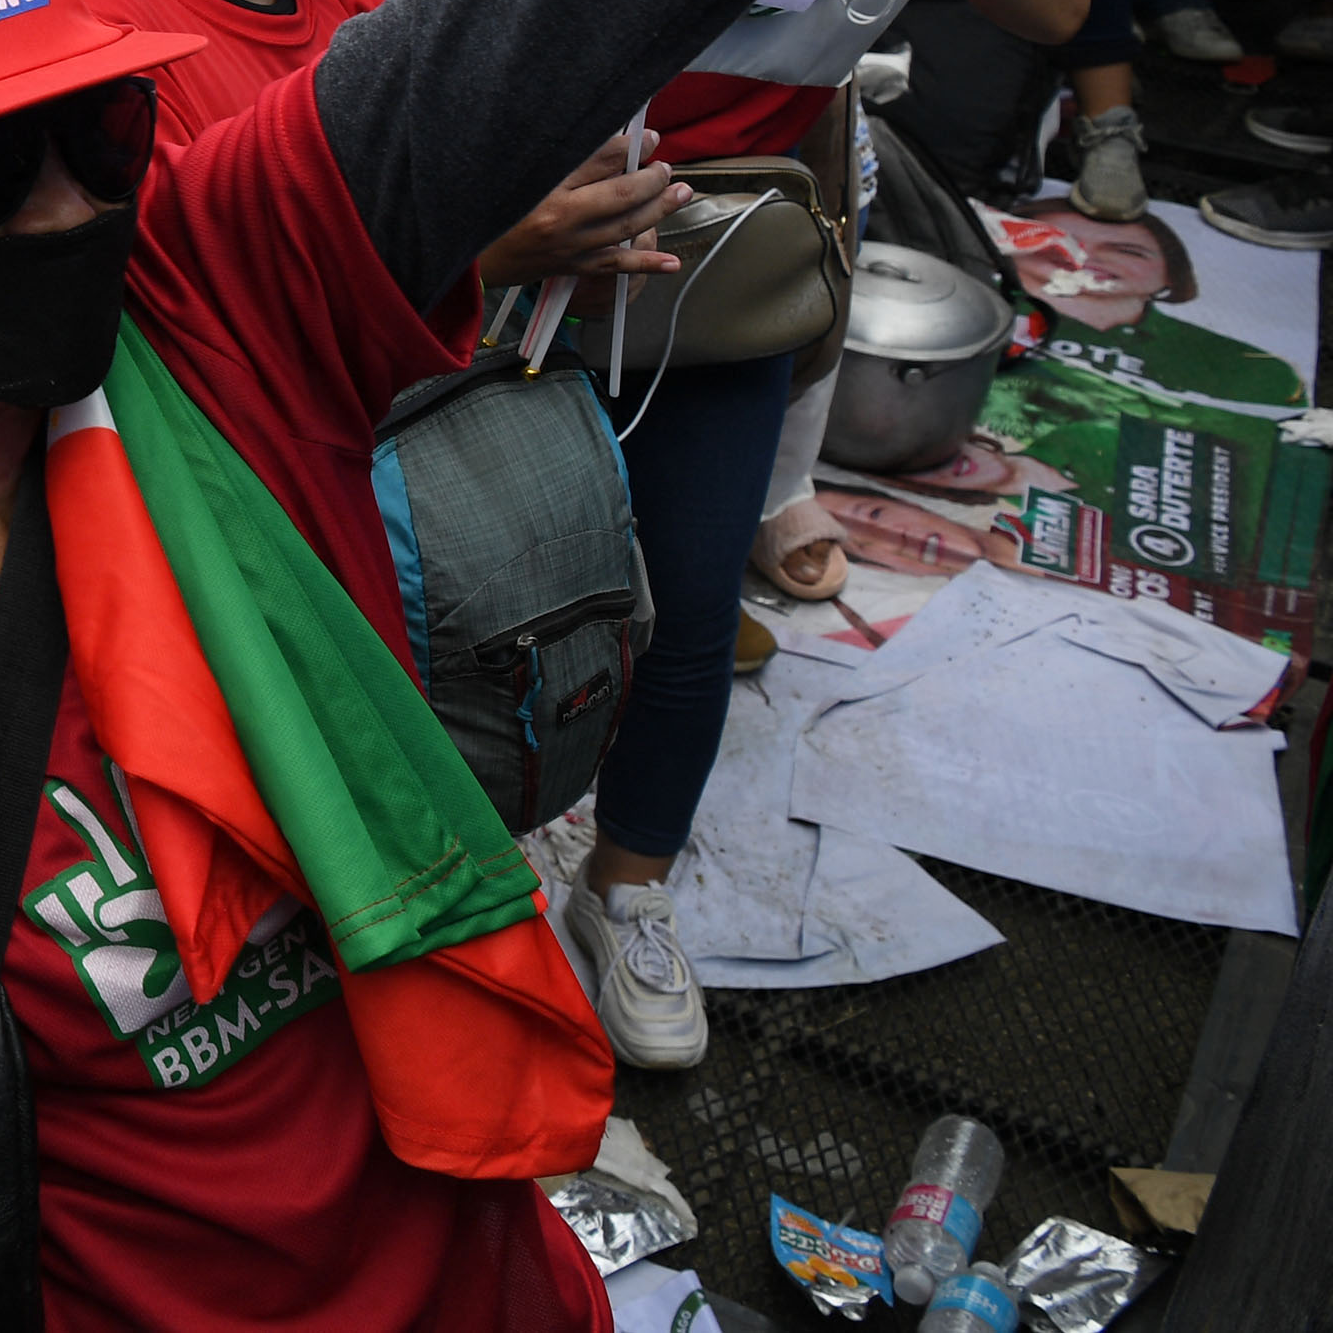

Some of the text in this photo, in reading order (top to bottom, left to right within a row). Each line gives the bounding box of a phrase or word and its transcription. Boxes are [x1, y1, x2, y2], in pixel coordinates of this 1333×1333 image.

[1128, 465, 1161, 523] SARA
[1160, 428, 1195, 532] DUTERTE
[1211, 446, 1232, 515] PRESIDENT
[238, 924, 307, 979] GEN
[152, 947, 338, 1089] BBM-SA
